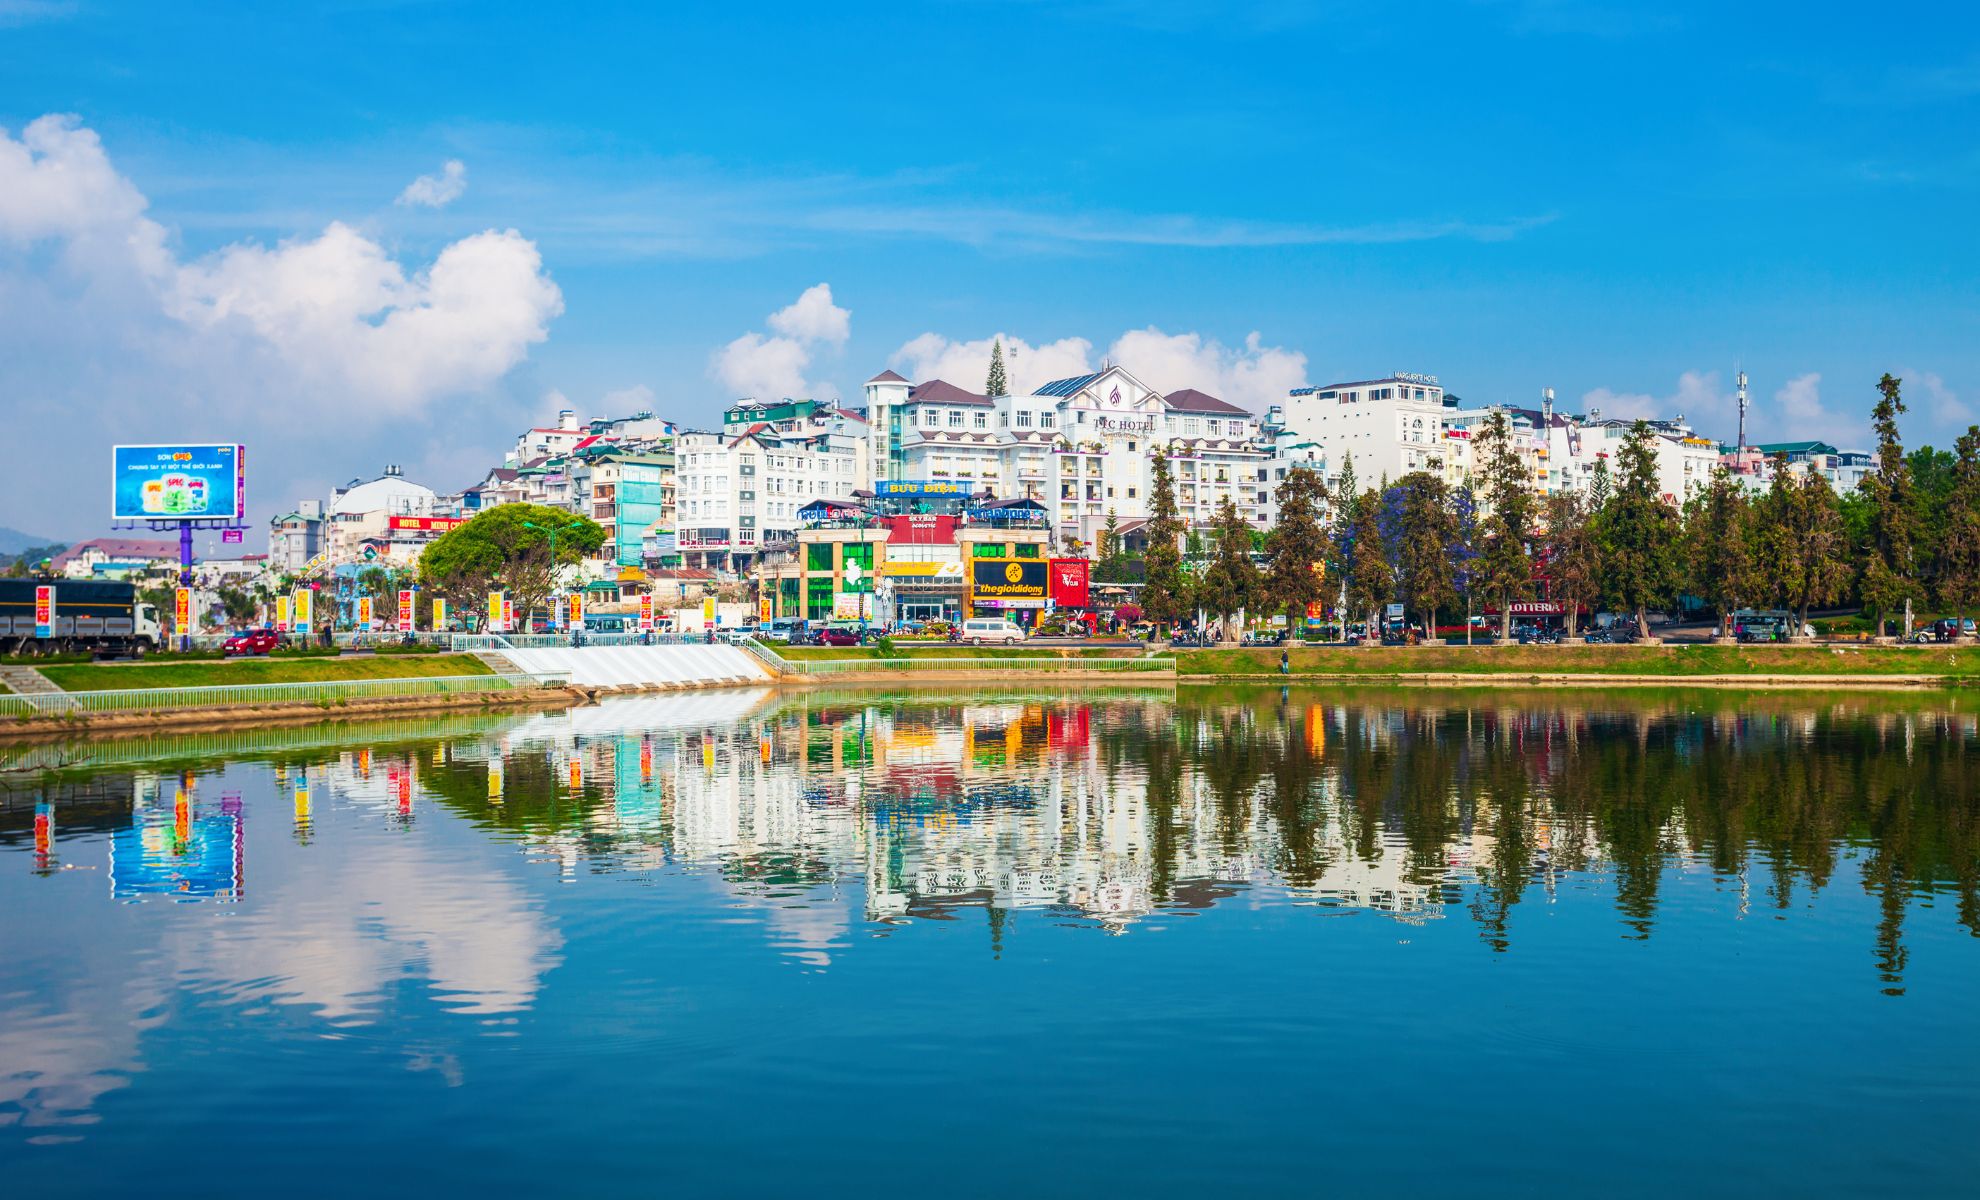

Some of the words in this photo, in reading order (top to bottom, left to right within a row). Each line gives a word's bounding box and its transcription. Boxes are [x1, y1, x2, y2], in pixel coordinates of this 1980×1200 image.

[1423, 374, 1438, 383] HOTEL
[1093, 418, 1116, 429] TTC
[1119, 420, 1156, 431] HOTEL
[167, 478, 185, 487] SPEC
[399, 519, 421, 528] HOTEL
[430, 521, 449, 530] MINH
[979, 583, 1043, 595] thegioididong
[1509, 603, 1560, 612] LOTTERIA
